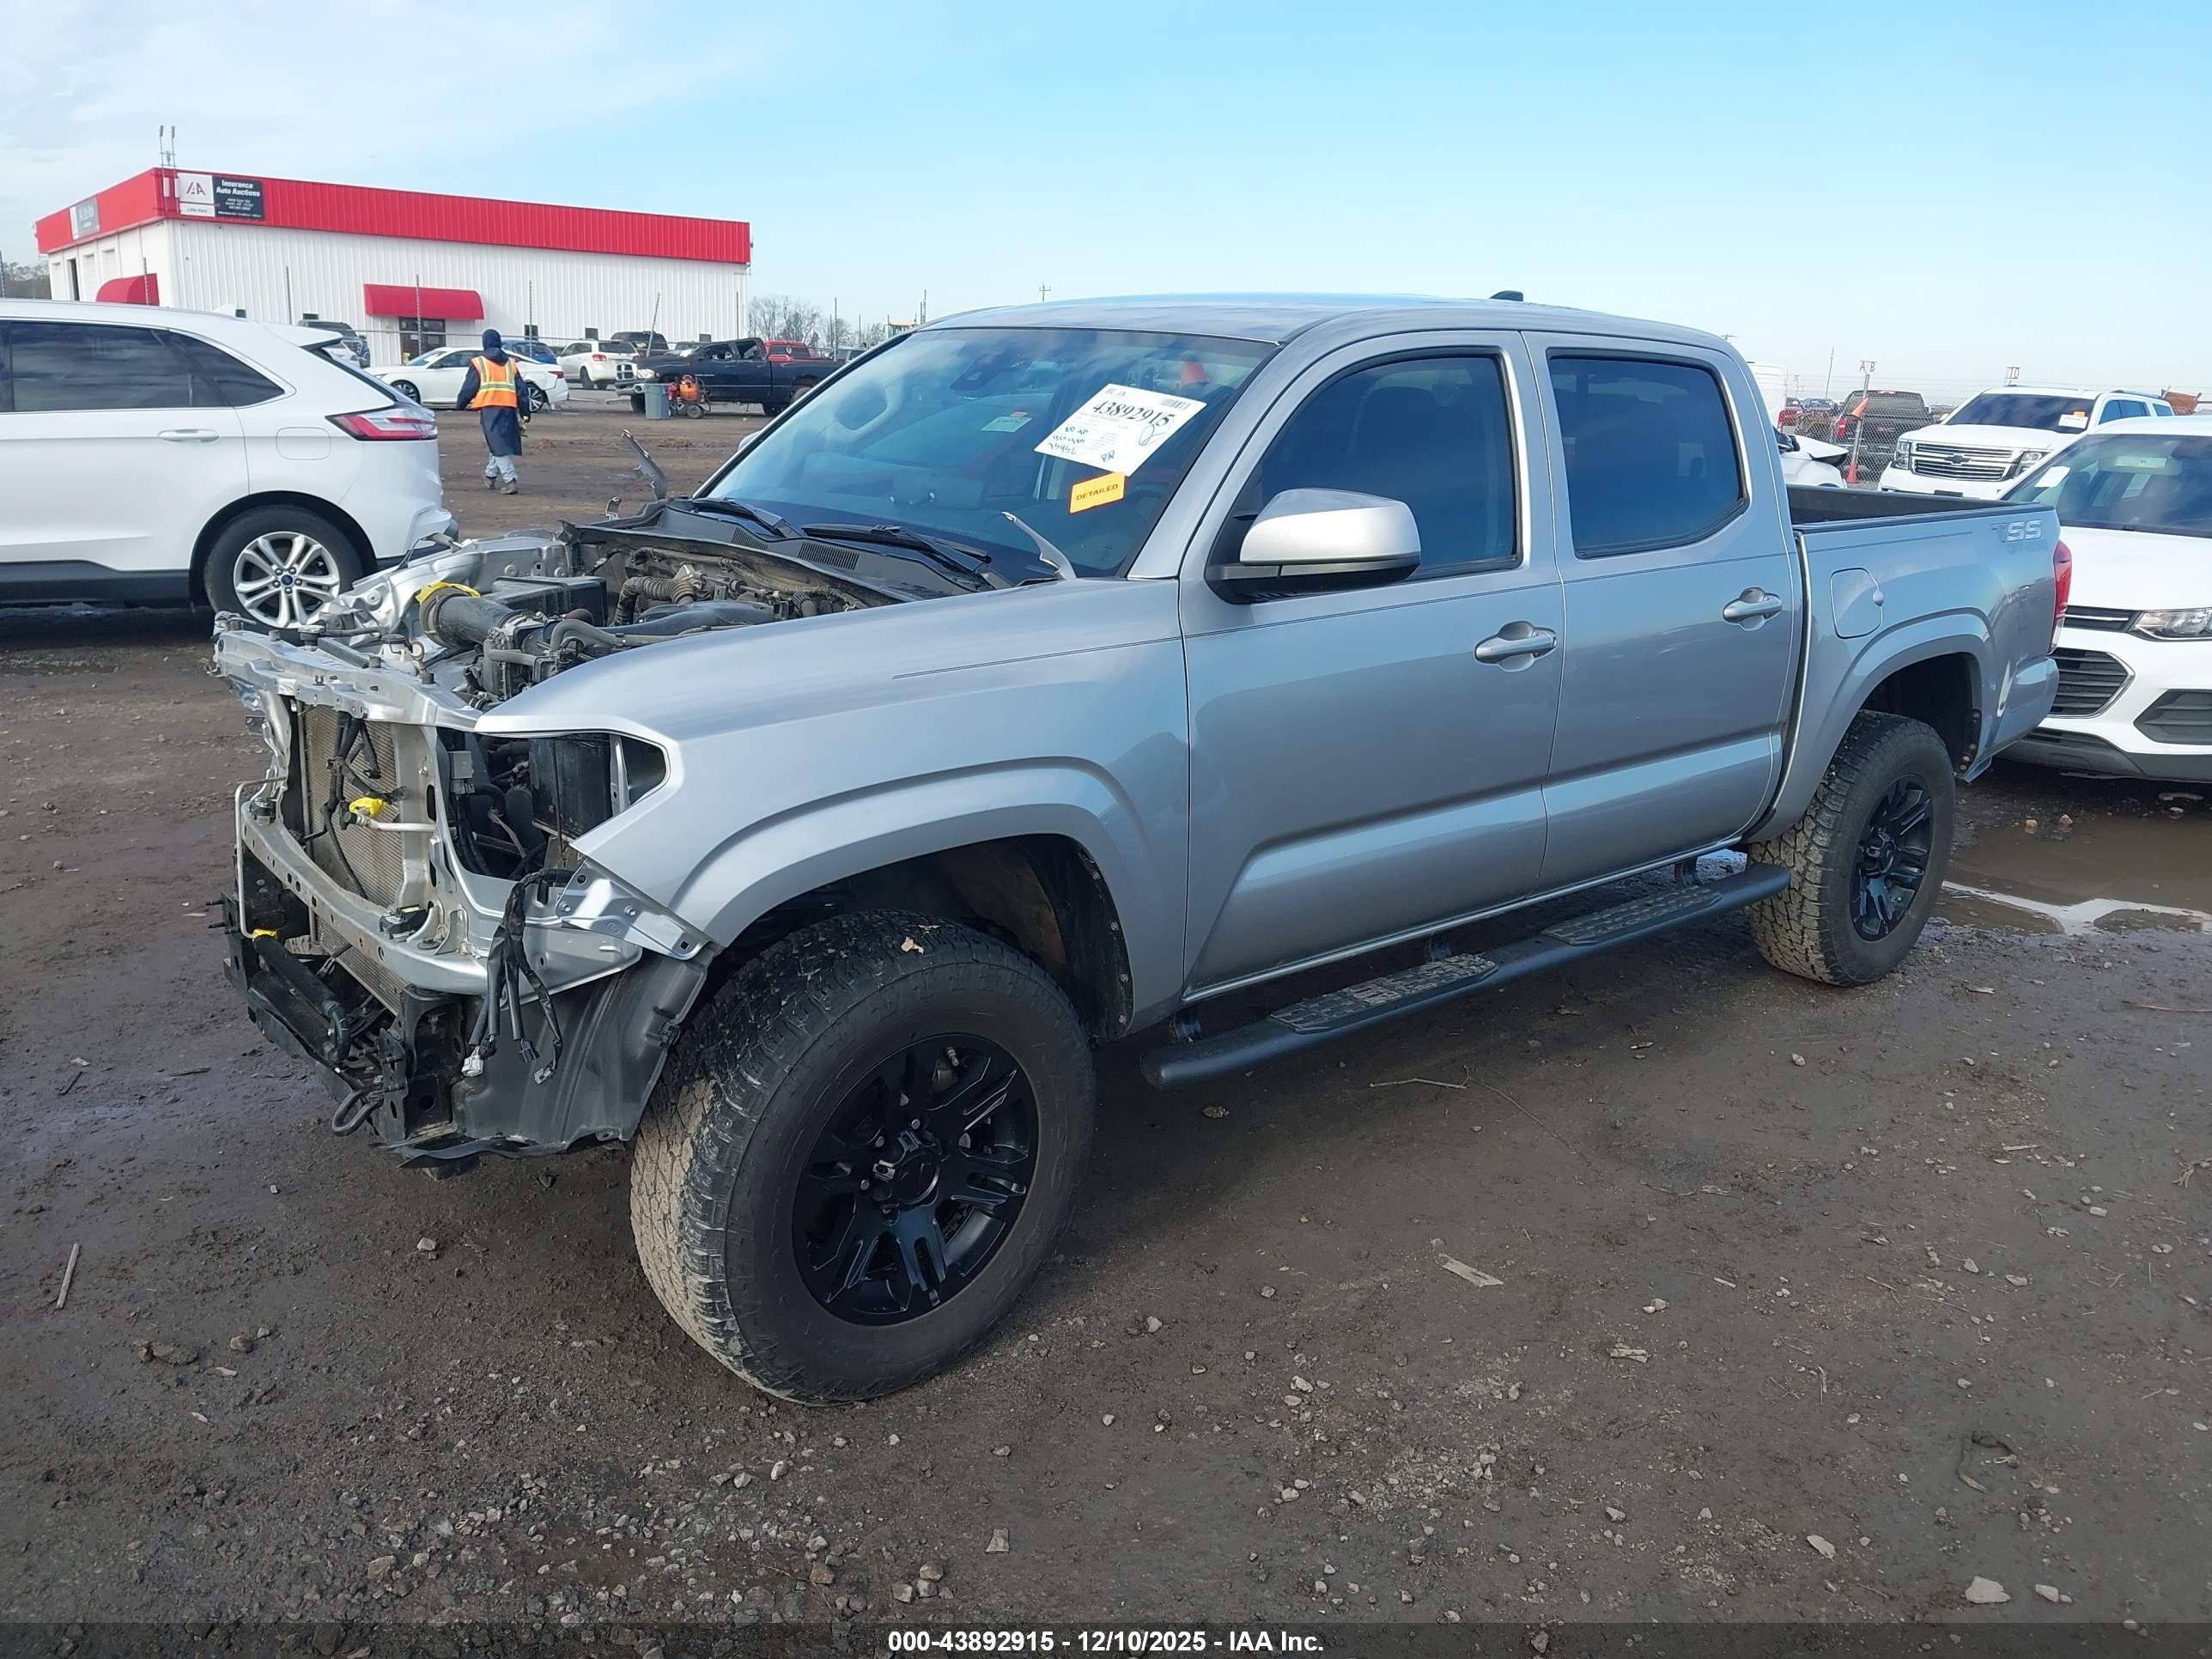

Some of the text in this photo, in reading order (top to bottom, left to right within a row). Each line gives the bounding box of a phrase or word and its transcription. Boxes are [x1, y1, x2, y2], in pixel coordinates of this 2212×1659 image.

[222, 179, 254, 189] Insurance
[216, 186, 261, 198] Auto Auctions
[1092, 400, 1176, 427] 43892915
[1076, 483, 1119, 501] DETAILED
